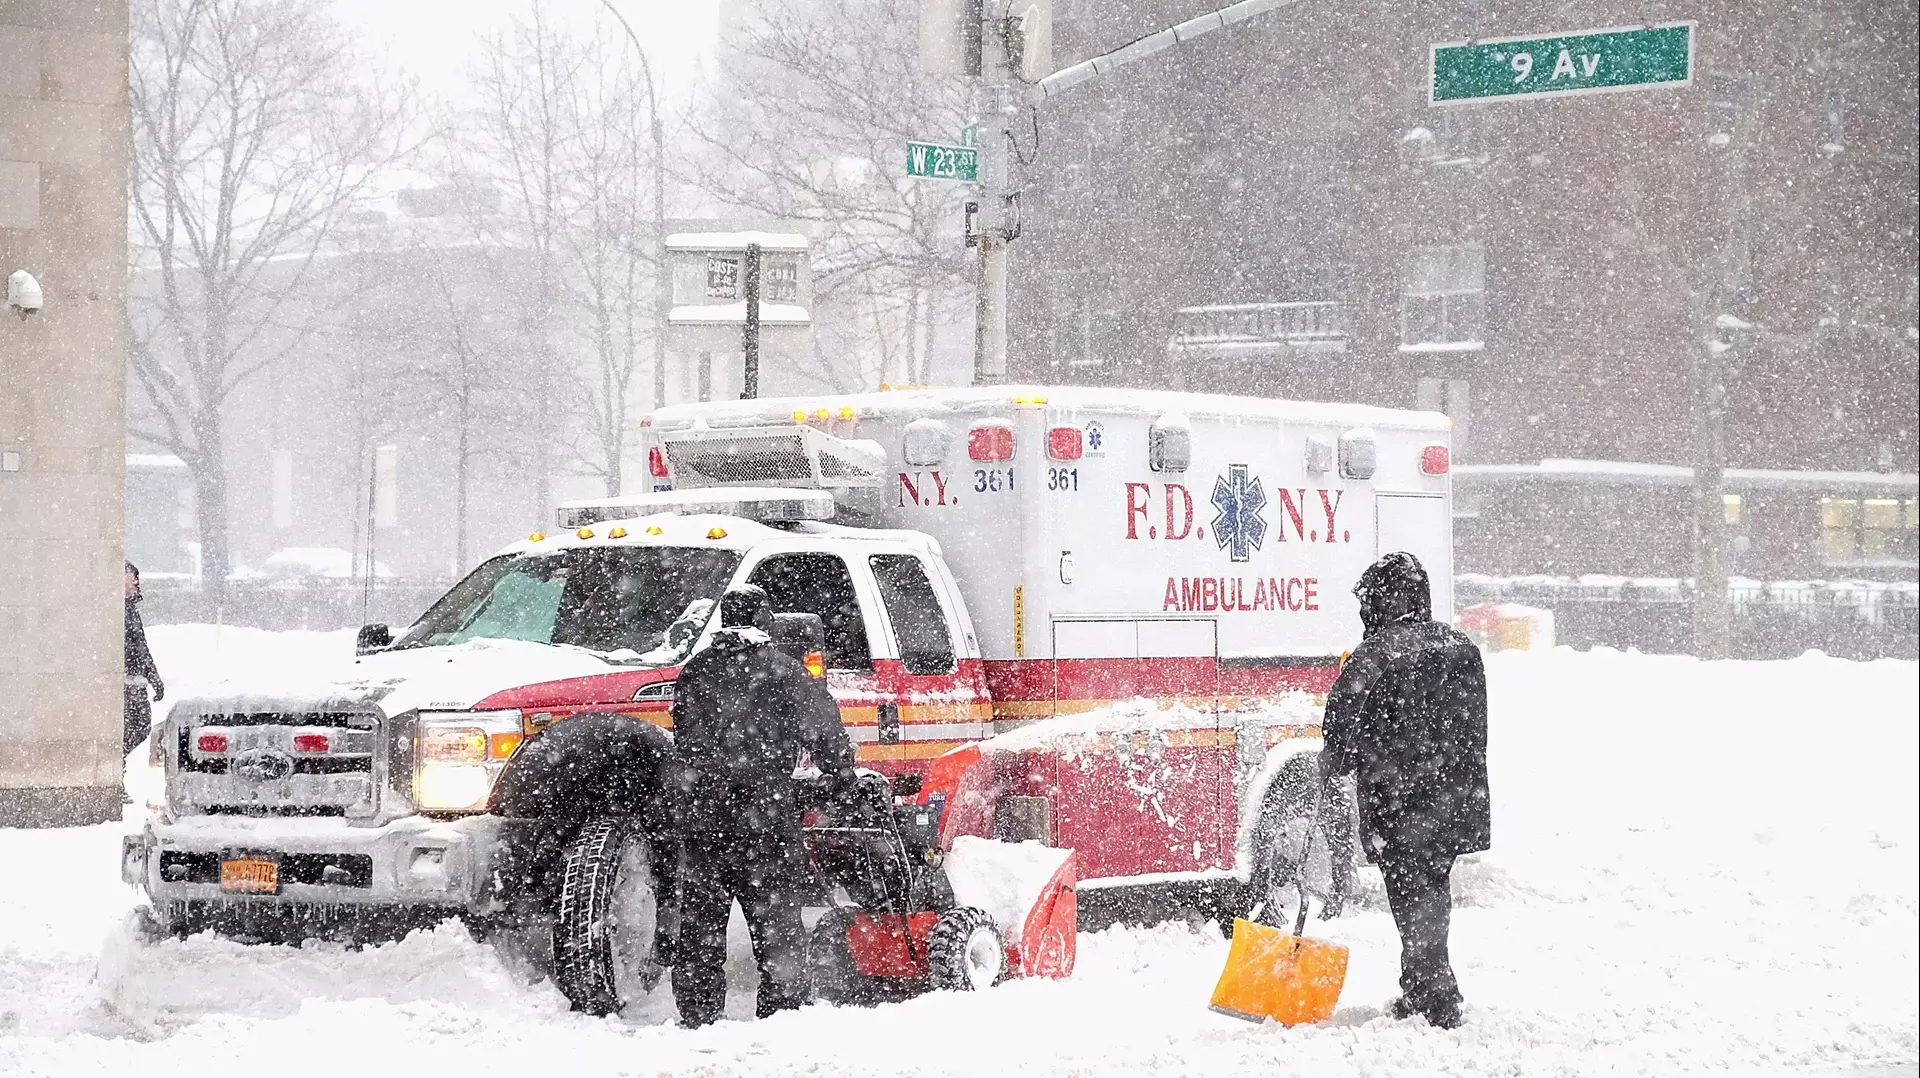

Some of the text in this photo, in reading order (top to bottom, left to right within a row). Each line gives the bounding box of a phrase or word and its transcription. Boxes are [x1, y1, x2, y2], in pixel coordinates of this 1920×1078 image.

[1512, 49, 1601, 84] 9 Av
[911, 145, 976, 177] W 23 ST
[897, 471, 958, 508] N.Y.
[973, 467, 1015, 493] 361
[1047, 467, 1078, 491] 361
[1125, 482, 1351, 544] F.D. N.Y.
[1162, 577, 1320, 612] AMBULANCE
